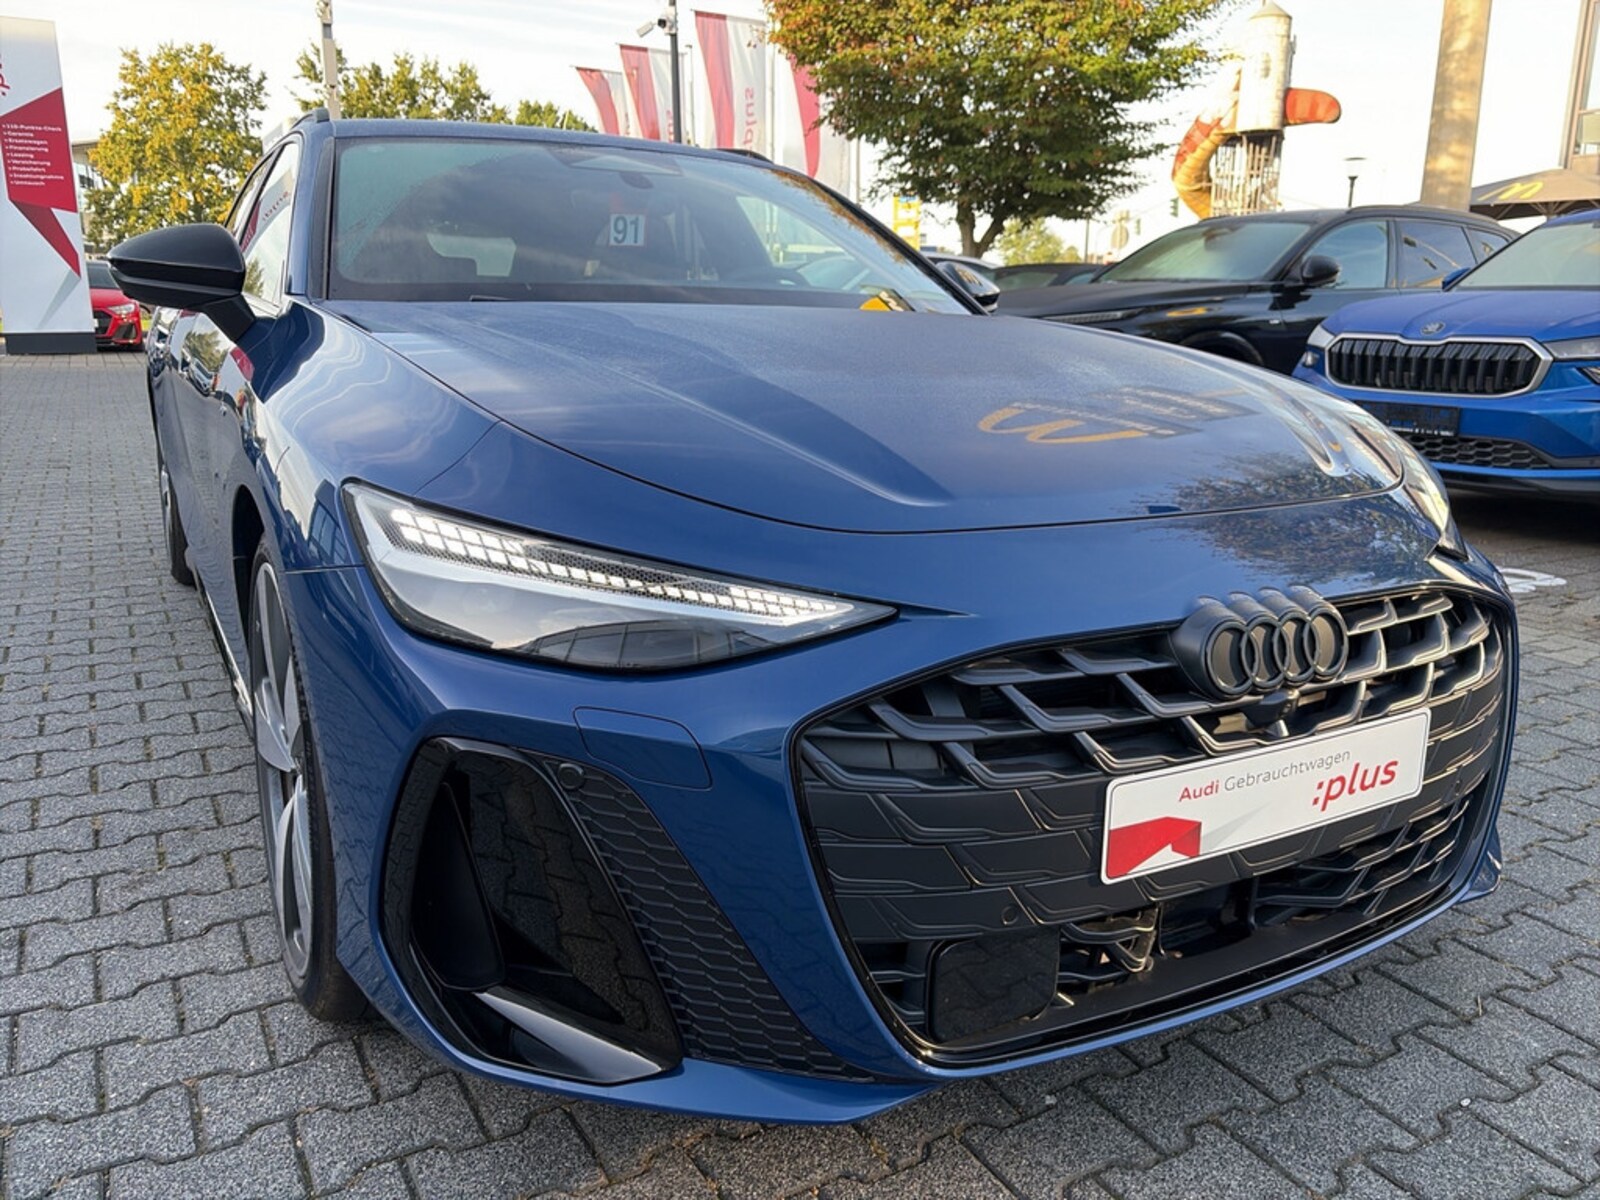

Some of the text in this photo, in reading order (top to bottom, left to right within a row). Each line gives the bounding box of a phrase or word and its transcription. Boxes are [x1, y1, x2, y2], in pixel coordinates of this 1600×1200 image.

[613, 216, 639, 244] 91
[1179, 750, 1351, 802] Audi Gebrauchtwagen
[1312, 760, 1399, 812] :plus
